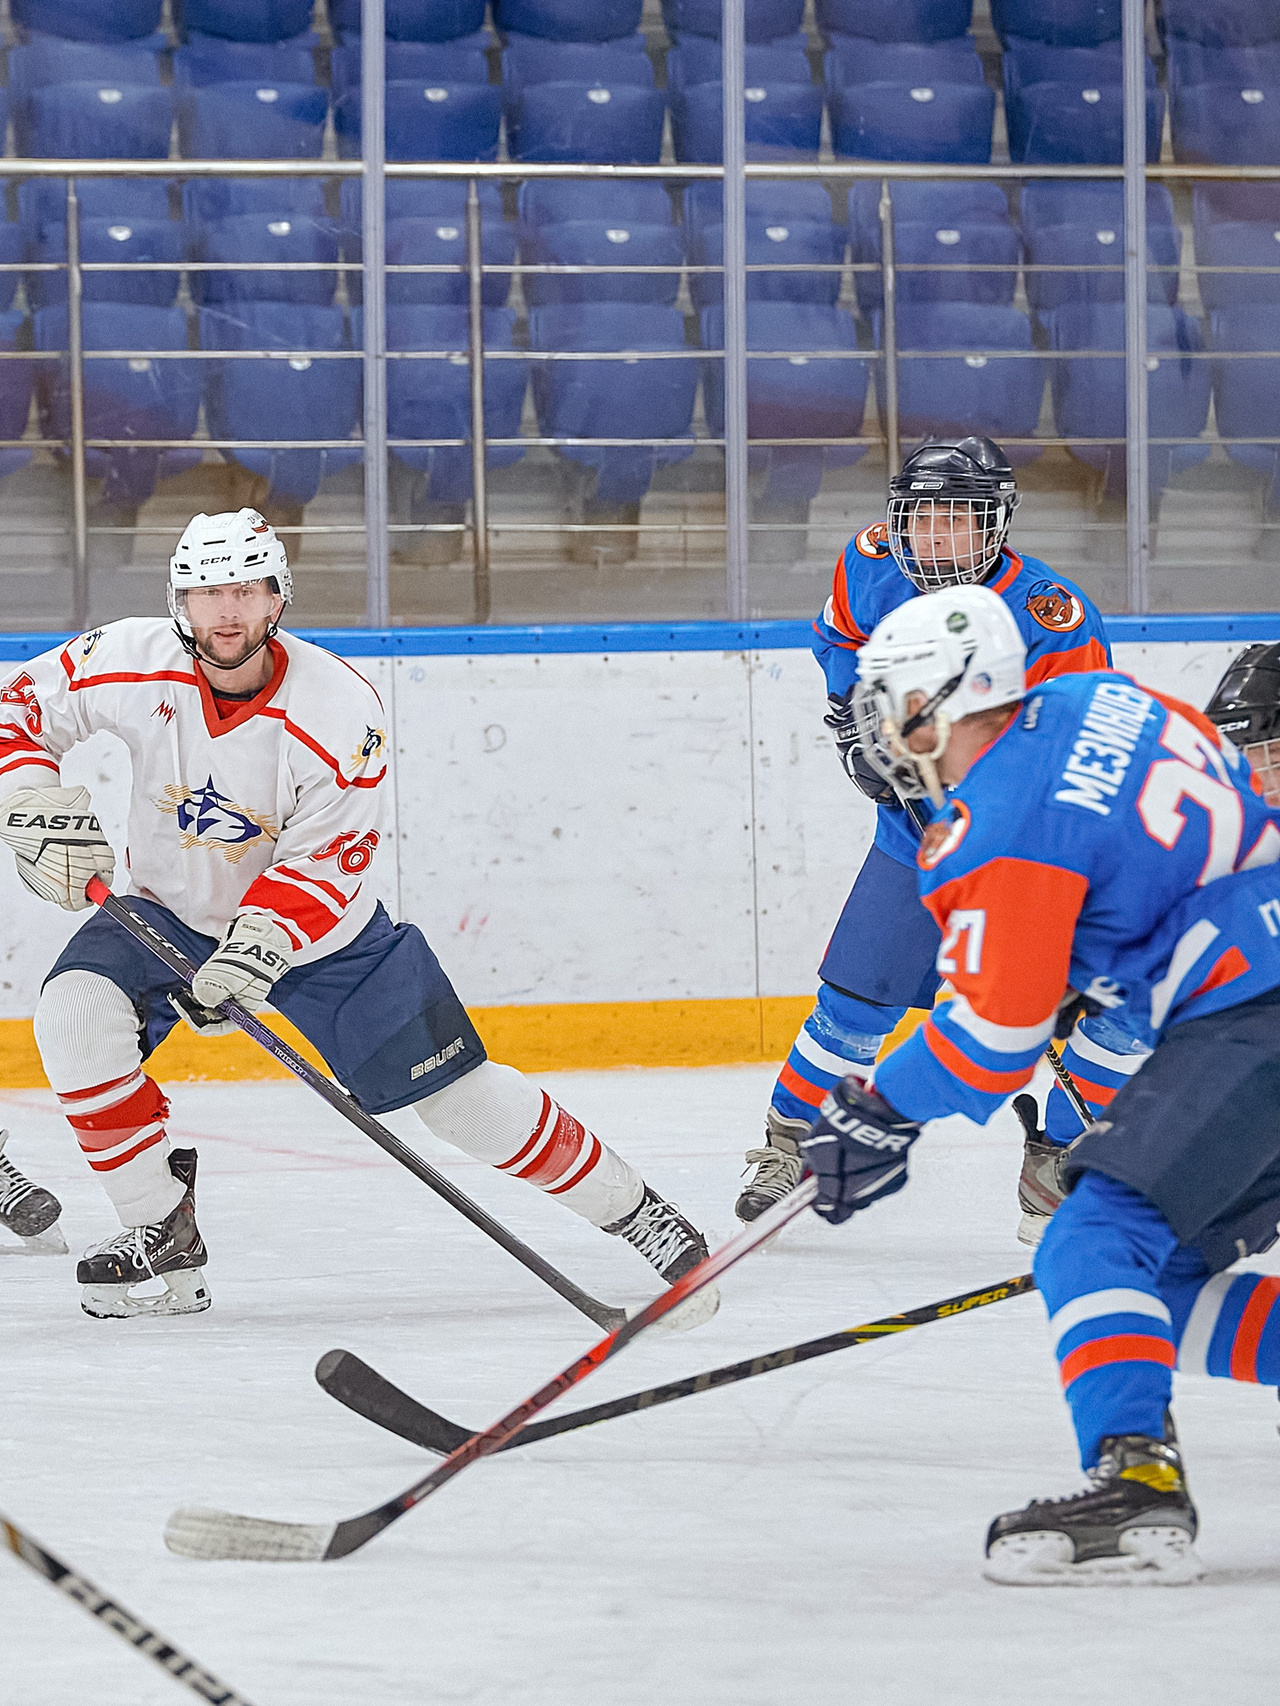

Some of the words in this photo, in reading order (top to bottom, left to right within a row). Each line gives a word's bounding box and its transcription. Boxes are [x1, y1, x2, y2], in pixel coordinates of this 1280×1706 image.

[200, 555, 231, 565] CCM
[1217, 719, 1250, 733] CCM
[7, 812, 103, 833] EASTO
[129, 911, 188, 960] CCM
[936, 908, 986, 974] 27
[410, 1036, 466, 1080] BAUER
[150, 1238, 176, 1262] CCM
[936, 1287, 1010, 1318] SUPER
[54, 1570, 260, 1706] BAUE
